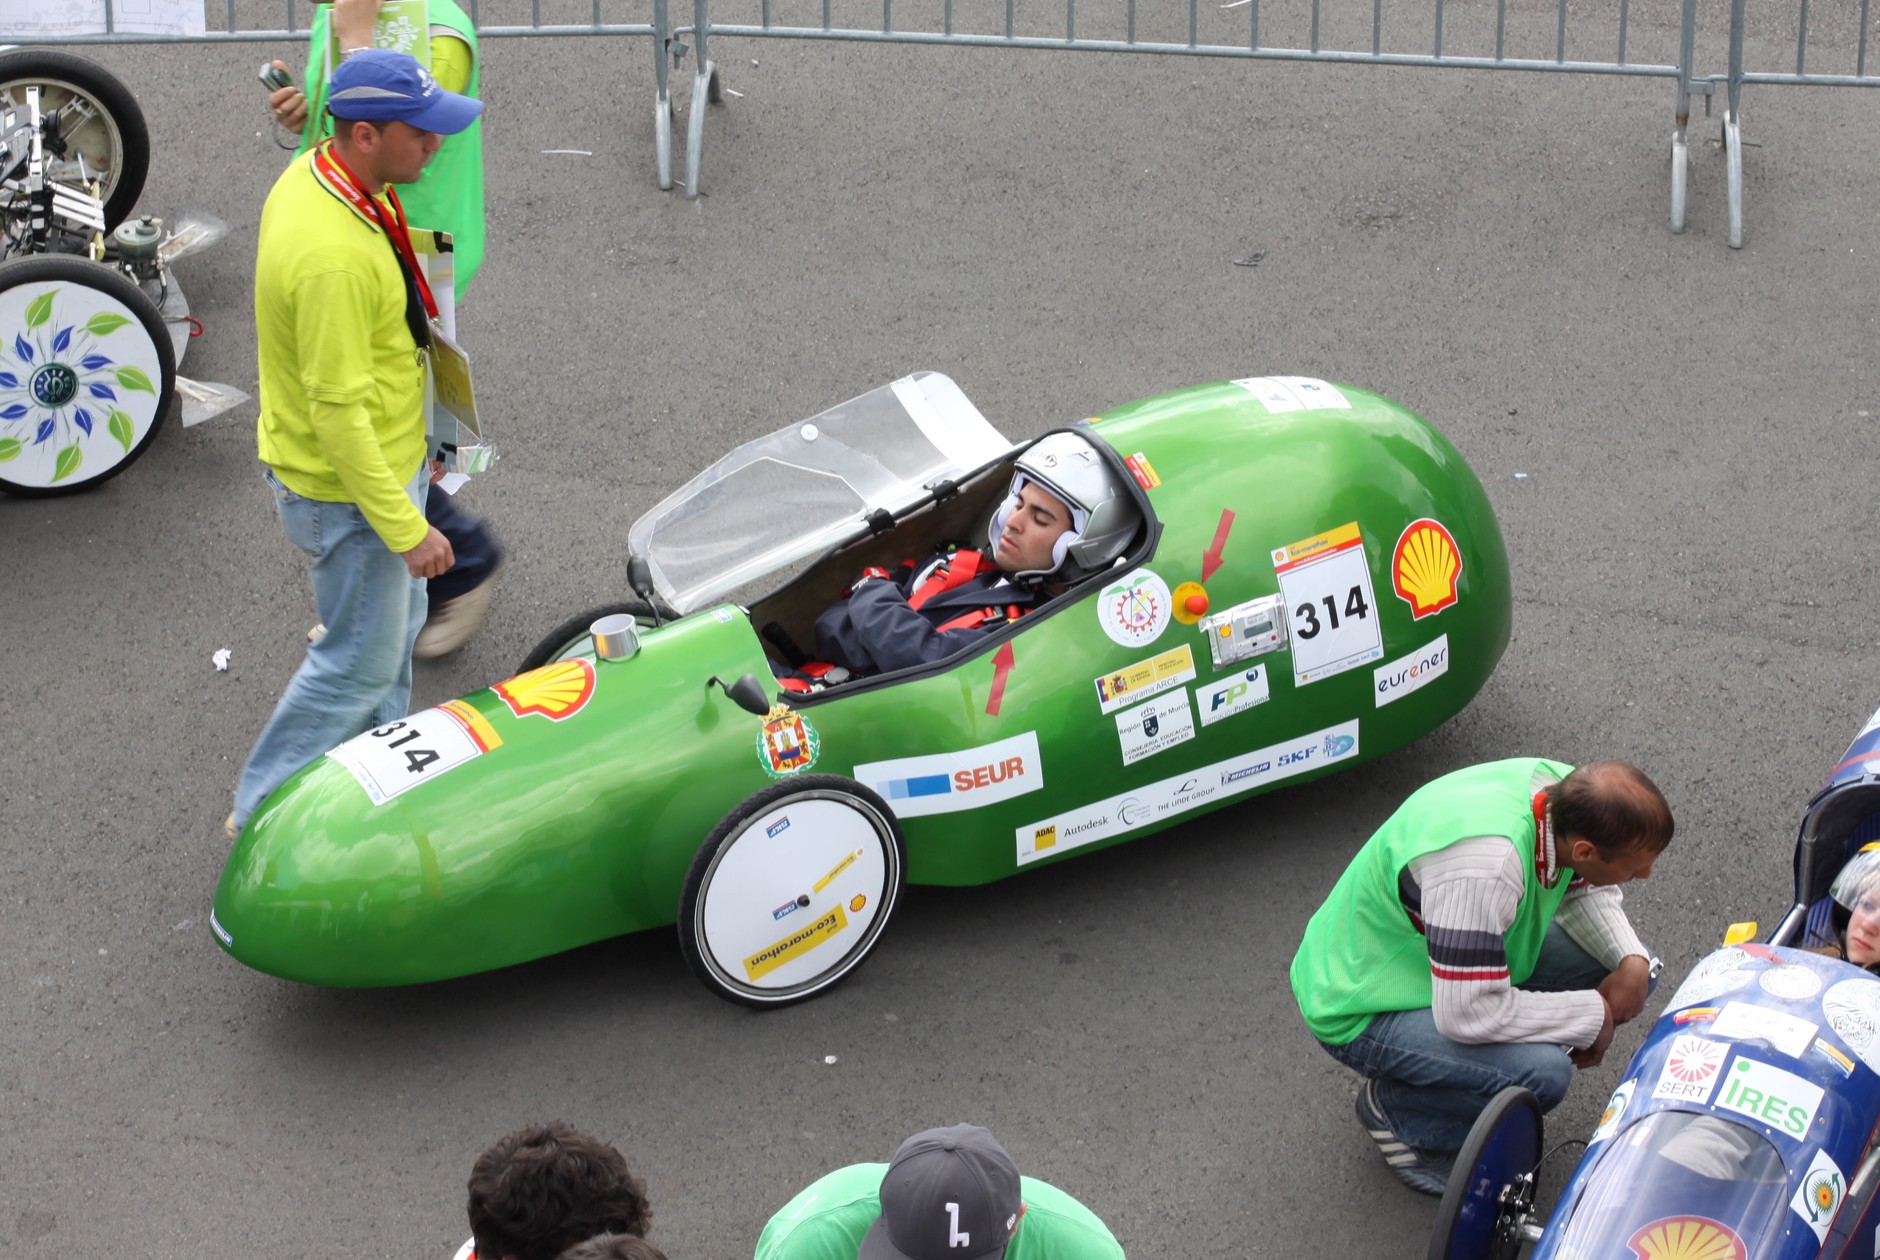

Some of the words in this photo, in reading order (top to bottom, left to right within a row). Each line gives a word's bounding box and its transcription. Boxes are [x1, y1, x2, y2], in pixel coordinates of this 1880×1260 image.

[1296, 585, 1368, 640] 314
[1378, 647, 1446, 692] eurener
[1119, 689, 1155, 705] Programa
[1156, 676, 1179, 691] ARCE
[1211, 681, 1248, 712] FP
[1120, 723, 1141, 735] Región
[1168, 702, 1190, 715] Murcia
[1160, 724, 1192, 741] EDUCACIÓN
[371, 721, 440, 773] 314
[1129, 744, 1161, 760] FORMACIÓN
[1166, 731, 1189, 744] EMPLEO
[1278, 745, 1318, 767] SKF
[954, 756, 1024, 792] SEUR
[1230, 762, 1270, 780] MICHELIN
[1157, 802, 1170, 812] THE
[1191, 787, 1215, 800] GROUP
[1035, 825, 1056, 839] ADAC
[1064, 815, 1108, 838] Autodesk
[751, 914, 836, 966] Eco-marathon
[1659, 1081, 1708, 1098] SERT
